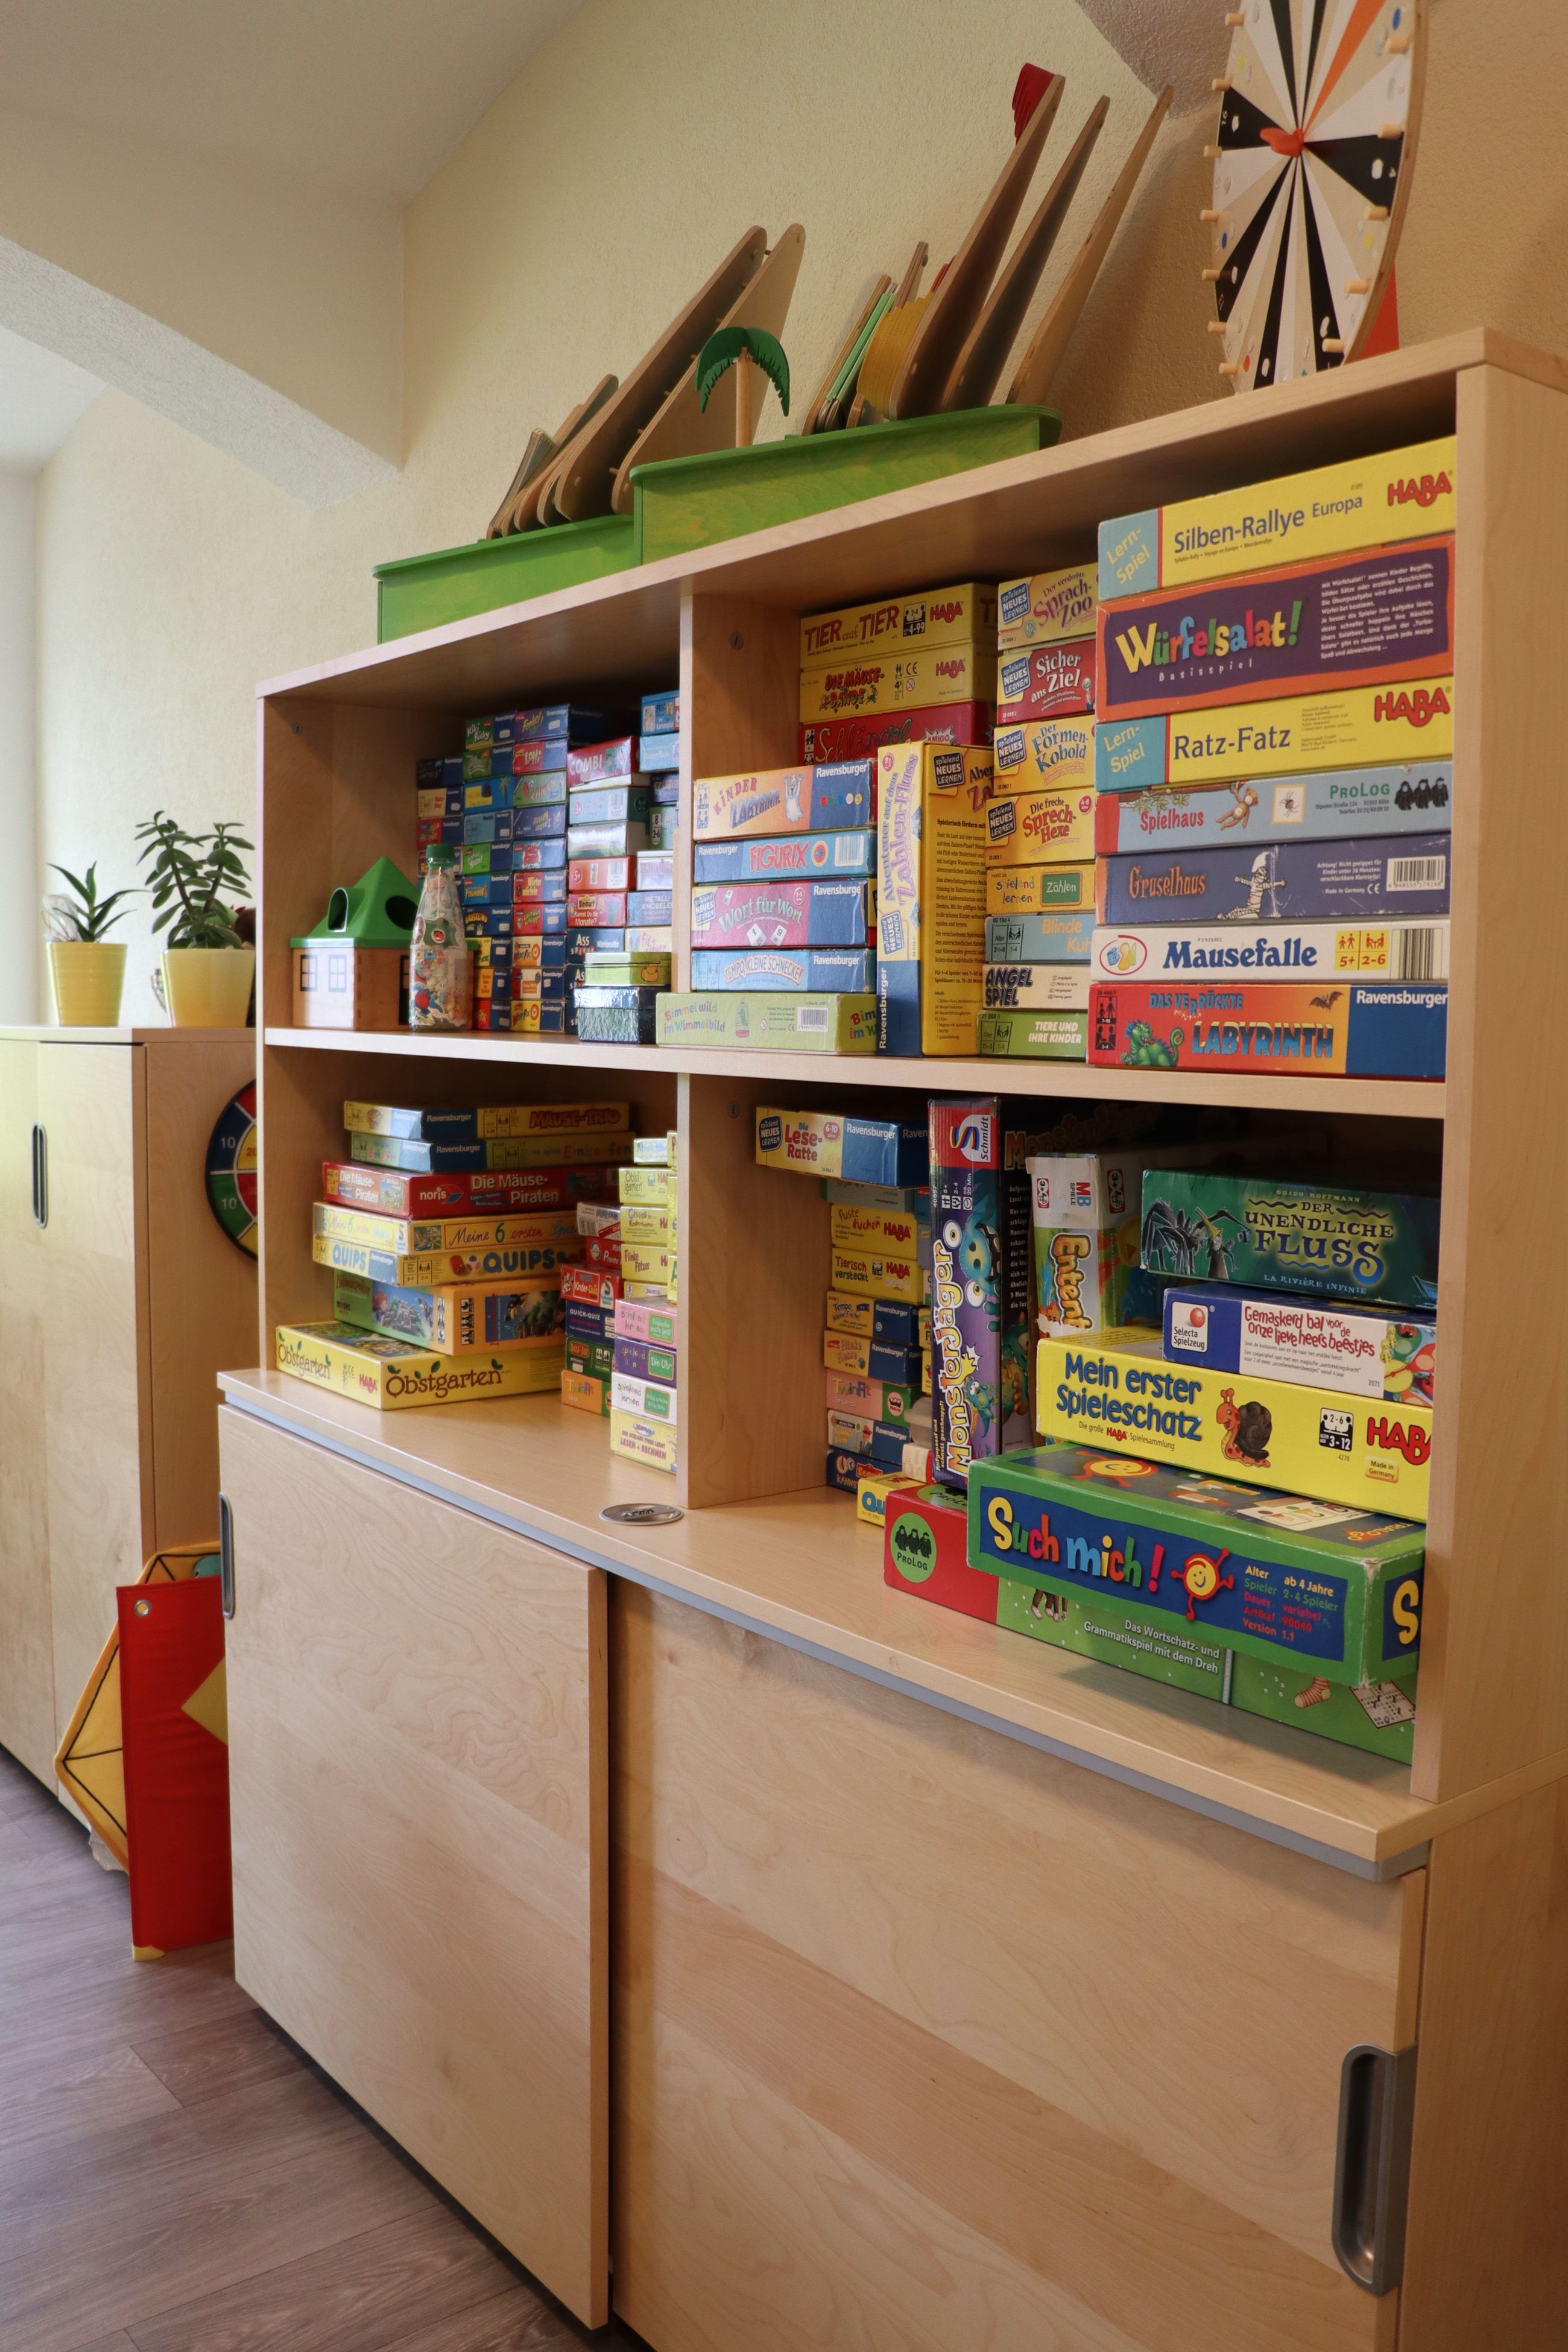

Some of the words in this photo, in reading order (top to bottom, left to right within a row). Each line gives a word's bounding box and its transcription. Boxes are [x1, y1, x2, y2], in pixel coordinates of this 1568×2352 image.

[1388, 472, 1452, 507] HABA
[1175, 509, 1305, 554] Silben-Rallye
[1312, 495, 1363, 517] Europa
[1107, 526, 1143, 564] Lern-
[1117, 546, 1151, 584] Spiel
[930, 601, 963, 623] HABA
[1034, 578, 1092, 627] Sprach-
[1057, 596, 1093, 628] Zoo
[805, 619, 842, 652] TIER
[859, 605, 900, 639] TIER
[1116, 601, 1302, 674] Würfelsalat!
[936, 659, 965, 678] HABA
[1003, 660, 1026, 676] spielend
[1037, 650, 1081, 678] Sicher
[1004, 669, 1028, 684] NEUES
[1005, 677, 1028, 696] LERNEN
[1031, 690, 1047, 703] ans
[1046, 669, 1081, 693] Ziel
[1374, 687, 1450, 727] HABA
[928, 734, 950, 742] AMIGO
[1041, 724, 1057, 737] Der
[1104, 724, 1140, 751] Lern-
[1032, 729, 1089, 754] Formen-
[1174, 726, 1291, 759] Ratz-Fatz
[569, 754, 602, 776] COMBI
[935, 753, 959, 767] spielend
[1035, 742, 1086, 773] Kobold
[1110, 742, 1145, 773] Spiel
[817, 763, 867, 778] Ravensburger
[937, 762, 961, 775] NEUES
[937, 773, 962, 786] LERNEN
[1030, 802, 1043, 814] Die
[1045, 797, 1064, 808] freche
[1022, 805, 1076, 838] Sprech-
[1140, 810, 1204, 833] Spielhaus
[1040, 824, 1069, 844] Hexe
[698, 845, 738, 856] Ravensburger
[750, 841, 810, 872] FIGURIX
[1046, 881, 1076, 894] Zählen
[1129, 866, 1206, 899] Gruselhaus
[718, 905, 756, 934] Wort
[756, 897, 774, 913] für
[777, 897, 803, 925] Wort
[1042, 918, 1082, 934] Blinde
[814, 956, 859, 965] Ravensburger
[1163, 938, 1317, 969] Mausefalle
[1339, 956, 1355, 967] 5+
[1362, 954, 1385, 965] 2-6
[986, 967, 1033, 987] ANGEL
[985, 987, 1019, 1007] SPIEL
[1149, 994, 1171, 1009] DAS
[1174, 991, 1244, 1015] VERRÜCKTE
[1356, 990, 1448, 1008] Ravensburger
[665, 1004, 696, 1021] Bimmel
[698, 1003, 717, 1014] wild
[675, 1019, 725, 1032] Wimmelbild
[1035, 1021, 1057, 1031] TIERE
[1060, 1022, 1078, 1032] UND
[1029, 1032, 1048, 1043] IHRE
[1049, 1034, 1082, 1043] KINDER
[1192, 1020, 1334, 1058] LABYRINTH
[426, 1113, 472, 1123] Ravensburger
[798, 1123, 809, 1131] Die
[785, 1125, 823, 1146] Lese-
[826, 1124, 838, 1133] 6-10
[847, 1123, 896, 1140] Ravensburger
[220, 1137, 236, 1149] 10
[437, 1145, 481, 1154] Ravensburger
[980, 1117, 988, 1162] Schmidt
[788, 1143, 818, 1162] Ratte
[472, 1176, 495, 1190] Die
[498, 1175, 549, 1188] Mäuse-
[221, 1198, 237, 1210] 10
[420, 1187, 447, 1201] noris
[510, 1189, 559, 1204] Piraten
[1076, 1182, 1091, 1206] MB
[1310, 1193, 1360, 1203] HOFFMANN
[1301, 1202, 1335, 1214] DER
[495, 1222, 505, 1243] 6
[884, 1223, 911, 1242] HABA
[1245, 1211, 1394, 1238] UNENDLICHE
[333, 1244, 366, 1272] QUIPS
[835, 1256, 867, 1271] Tierisch
[1254, 1229, 1384, 1285] FLUSS
[835, 1271, 868, 1282] versteckt
[887, 1262, 910, 1279] HABA
[1281, 1276, 1322, 1287] RIVIÈRE
[1327, 1283, 1367, 1294] INFINIE
[570, 1309, 601, 1321] QUICK-QUIZ
[1244, 1306, 1303, 1329] Gemaskerd
[1307, 1313, 1324, 1331] bal
[1326, 1318, 1343, 1328] voor
[1174, 1327, 1198, 1338] Selecta
[1248, 1322, 1273, 1339] onze
[1275, 1327, 1297, 1347] lieve
[1329, 1333, 1375, 1358] beestjes
[1341, 1326, 1350, 1336] de
[1174, 1336, 1205, 1350] Spielzeug
[278, 1344, 330, 1380] Obstgarten
[651, 1357, 660, 1367] Die
[662, 1358, 671, 1370] Uhr
[933, 1241, 971, 1477] Monsterjäger
[359, 1374, 378, 1394] HABA
[386, 1368, 503, 1399] Obstgarten
[1065, 1353, 1118, 1389] Mein
[1126, 1370, 1201, 1404] erster
[1057, 1384, 1203, 1441] Spieleschatz
[876, 1426, 907, 1441] Ravensburger
[1079, 1421, 1087, 1429] Die
[1089, 1423, 1104, 1434] große
[1107, 1427, 1127, 1441] HABA
[1369, 1468, 1395, 1478] Germany
[1370, 1460, 1386, 1469] Made
[988, 1497, 1059, 1562] Such
[1245, 1566, 1269, 1579] Alter
[1284, 1575, 1297, 1587] ab
[1299, 1579, 1305, 1589] 4
[1307, 1581, 1333, 1597] Jahre
[1244, 1578, 1277, 1595] Spieler
[1283, 1589, 1301, 1602] 2-4
[1303, 1593, 1338, 1611] Spieler
[1242, 1605, 1275, 1622] Artikel
[1244, 1592, 1271, 1608] Dauer
[1282, 1604, 1321, 1621] variabel
[1125, 1619, 1141, 1635] Das
[1144, 1625, 1198, 1651] Wortschatz-
[1201, 1645, 1219, 1659] und
[1242, 1618, 1277, 1636] Version
[1282, 1630, 1295, 1641] 1.1
[1084, 1622, 1153, 1652] Grammatikspiel
[1155, 1643, 1171, 1658] mit
[1172, 1650, 1193, 1666] dem
[1195, 1657, 1218, 1674] Dreh
